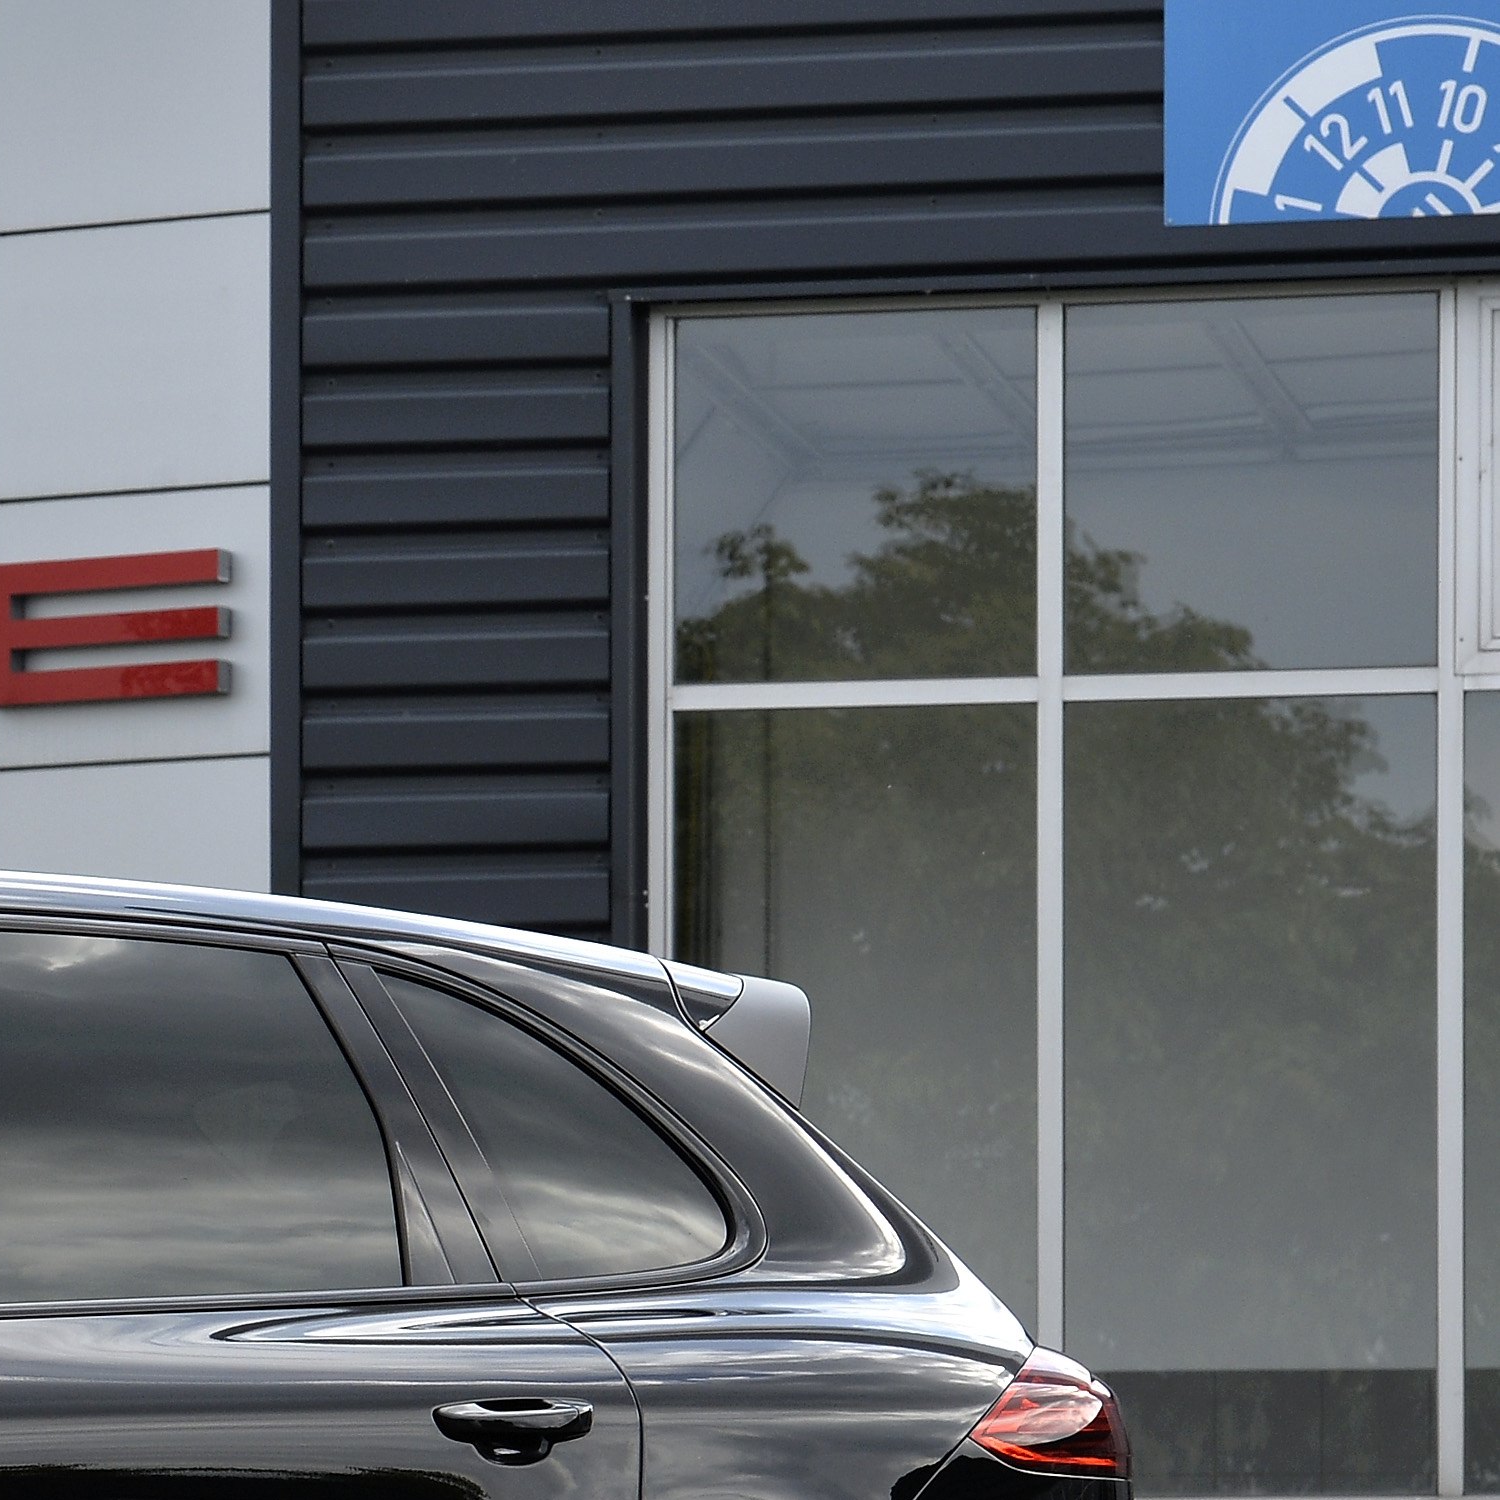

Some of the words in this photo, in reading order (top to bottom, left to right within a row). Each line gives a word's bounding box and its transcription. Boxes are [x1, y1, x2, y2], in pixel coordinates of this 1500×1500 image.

[1367, 80, 1414, 135] 11
[1438, 79, 1487, 134] 10
[1304, 113, 1368, 171] 12
